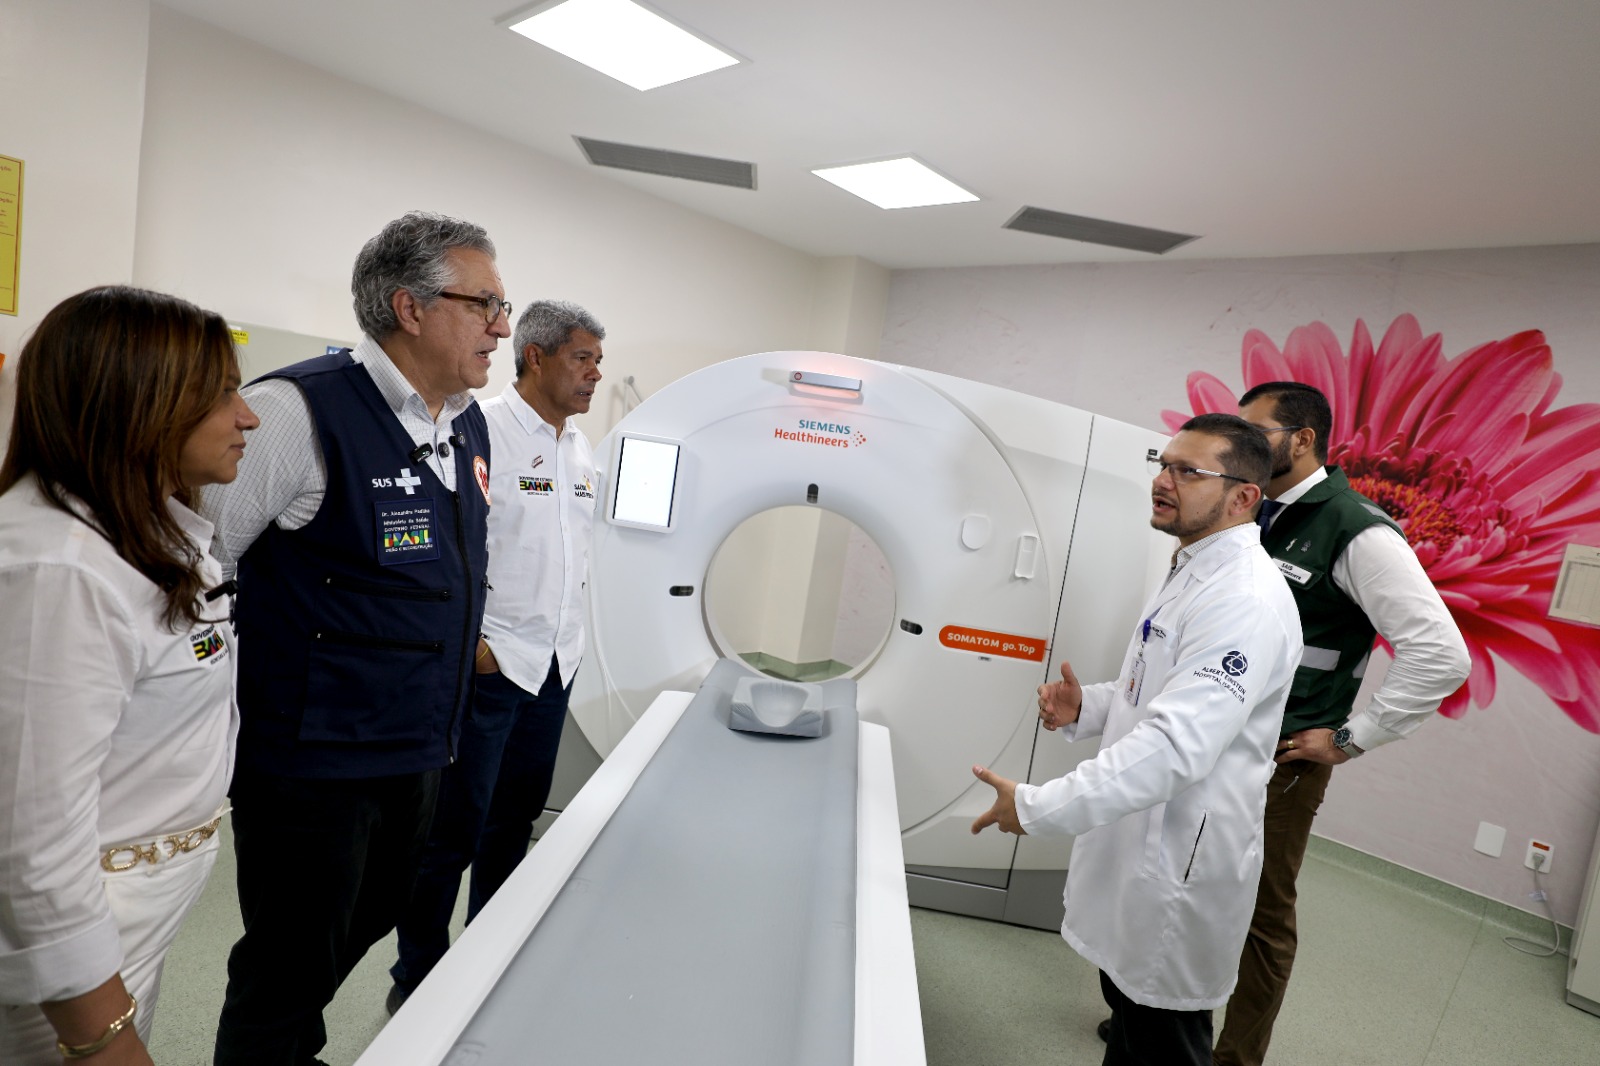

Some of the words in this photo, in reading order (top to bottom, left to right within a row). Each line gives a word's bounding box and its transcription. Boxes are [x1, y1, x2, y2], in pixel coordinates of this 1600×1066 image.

[799, 419, 851, 434] SIEMENS
[774, 428, 849, 448] Healthineers
[372, 478, 392, 488] SUS
[519, 480, 554, 492] BAHIA
[384, 529, 433, 548] BRASIL
[947, 632, 1000, 648] SOMATOM
[1193, 670, 1222, 685] HOSPITAL
[1202, 666, 1225, 677] ALBERT
[1224, 674, 1246, 695] EINSTEIN
